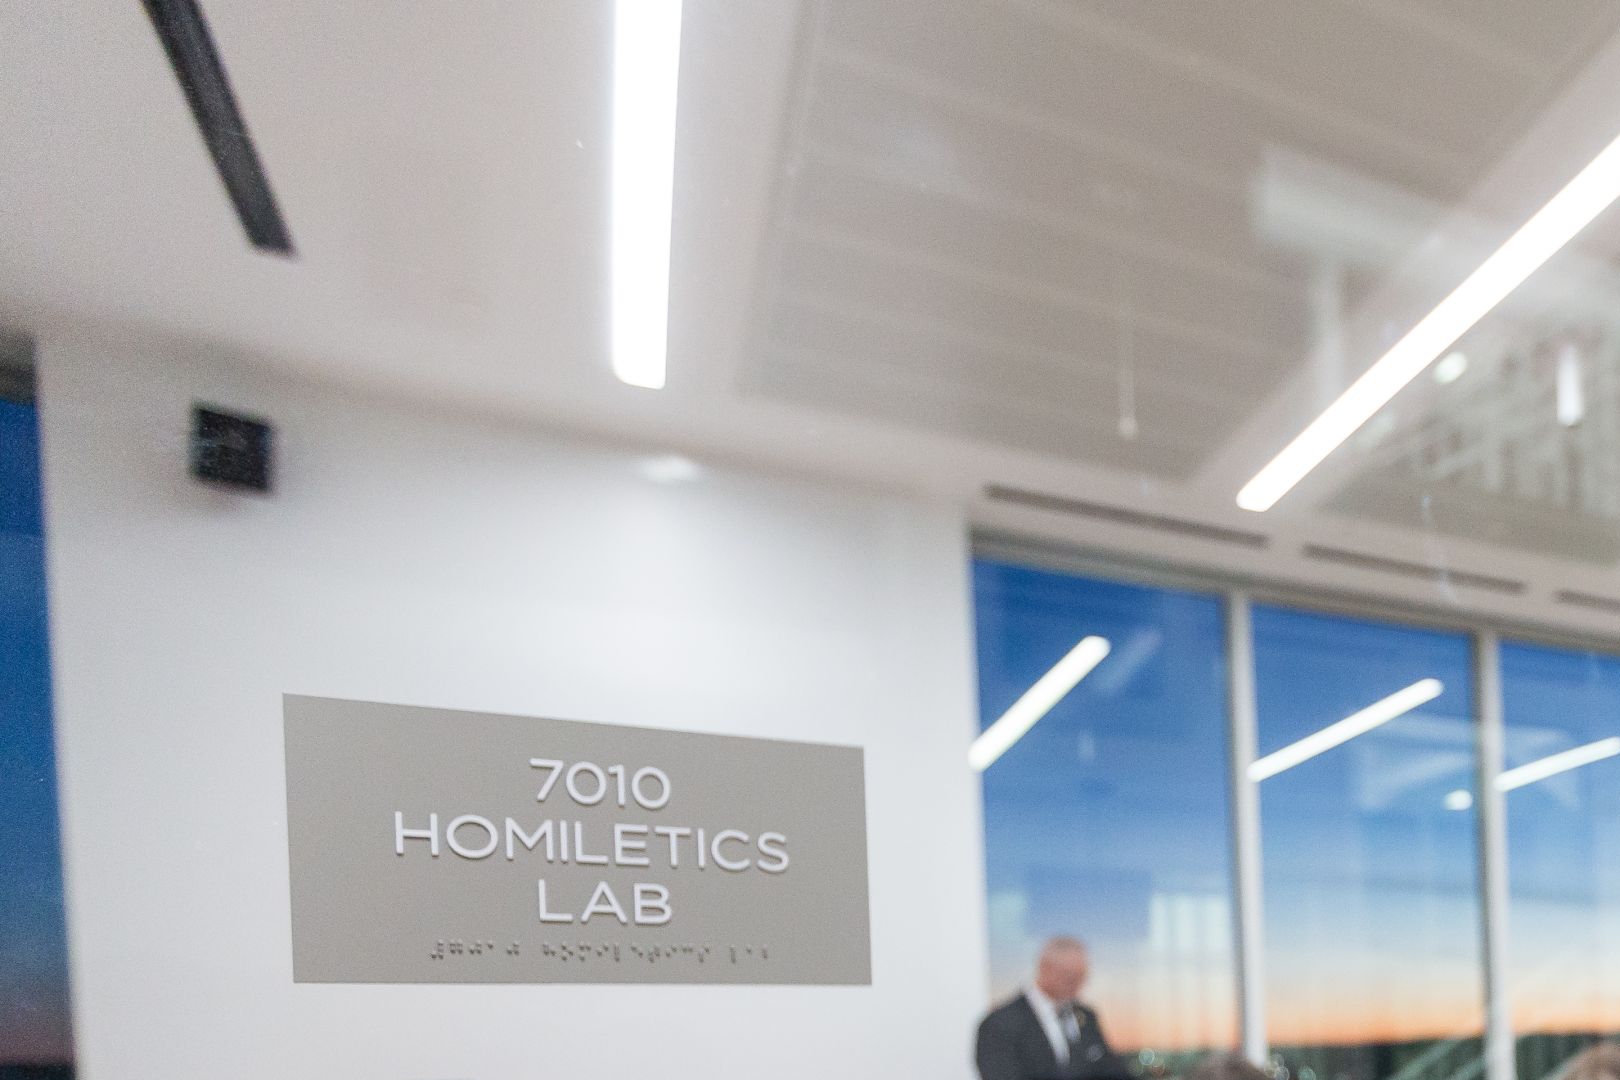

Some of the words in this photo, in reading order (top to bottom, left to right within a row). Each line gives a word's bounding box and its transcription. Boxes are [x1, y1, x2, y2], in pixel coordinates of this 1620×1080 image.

[529, 757, 671, 808] 7010
[394, 810, 790, 872] HOMILETICS
[538, 878, 673, 923] LAB
